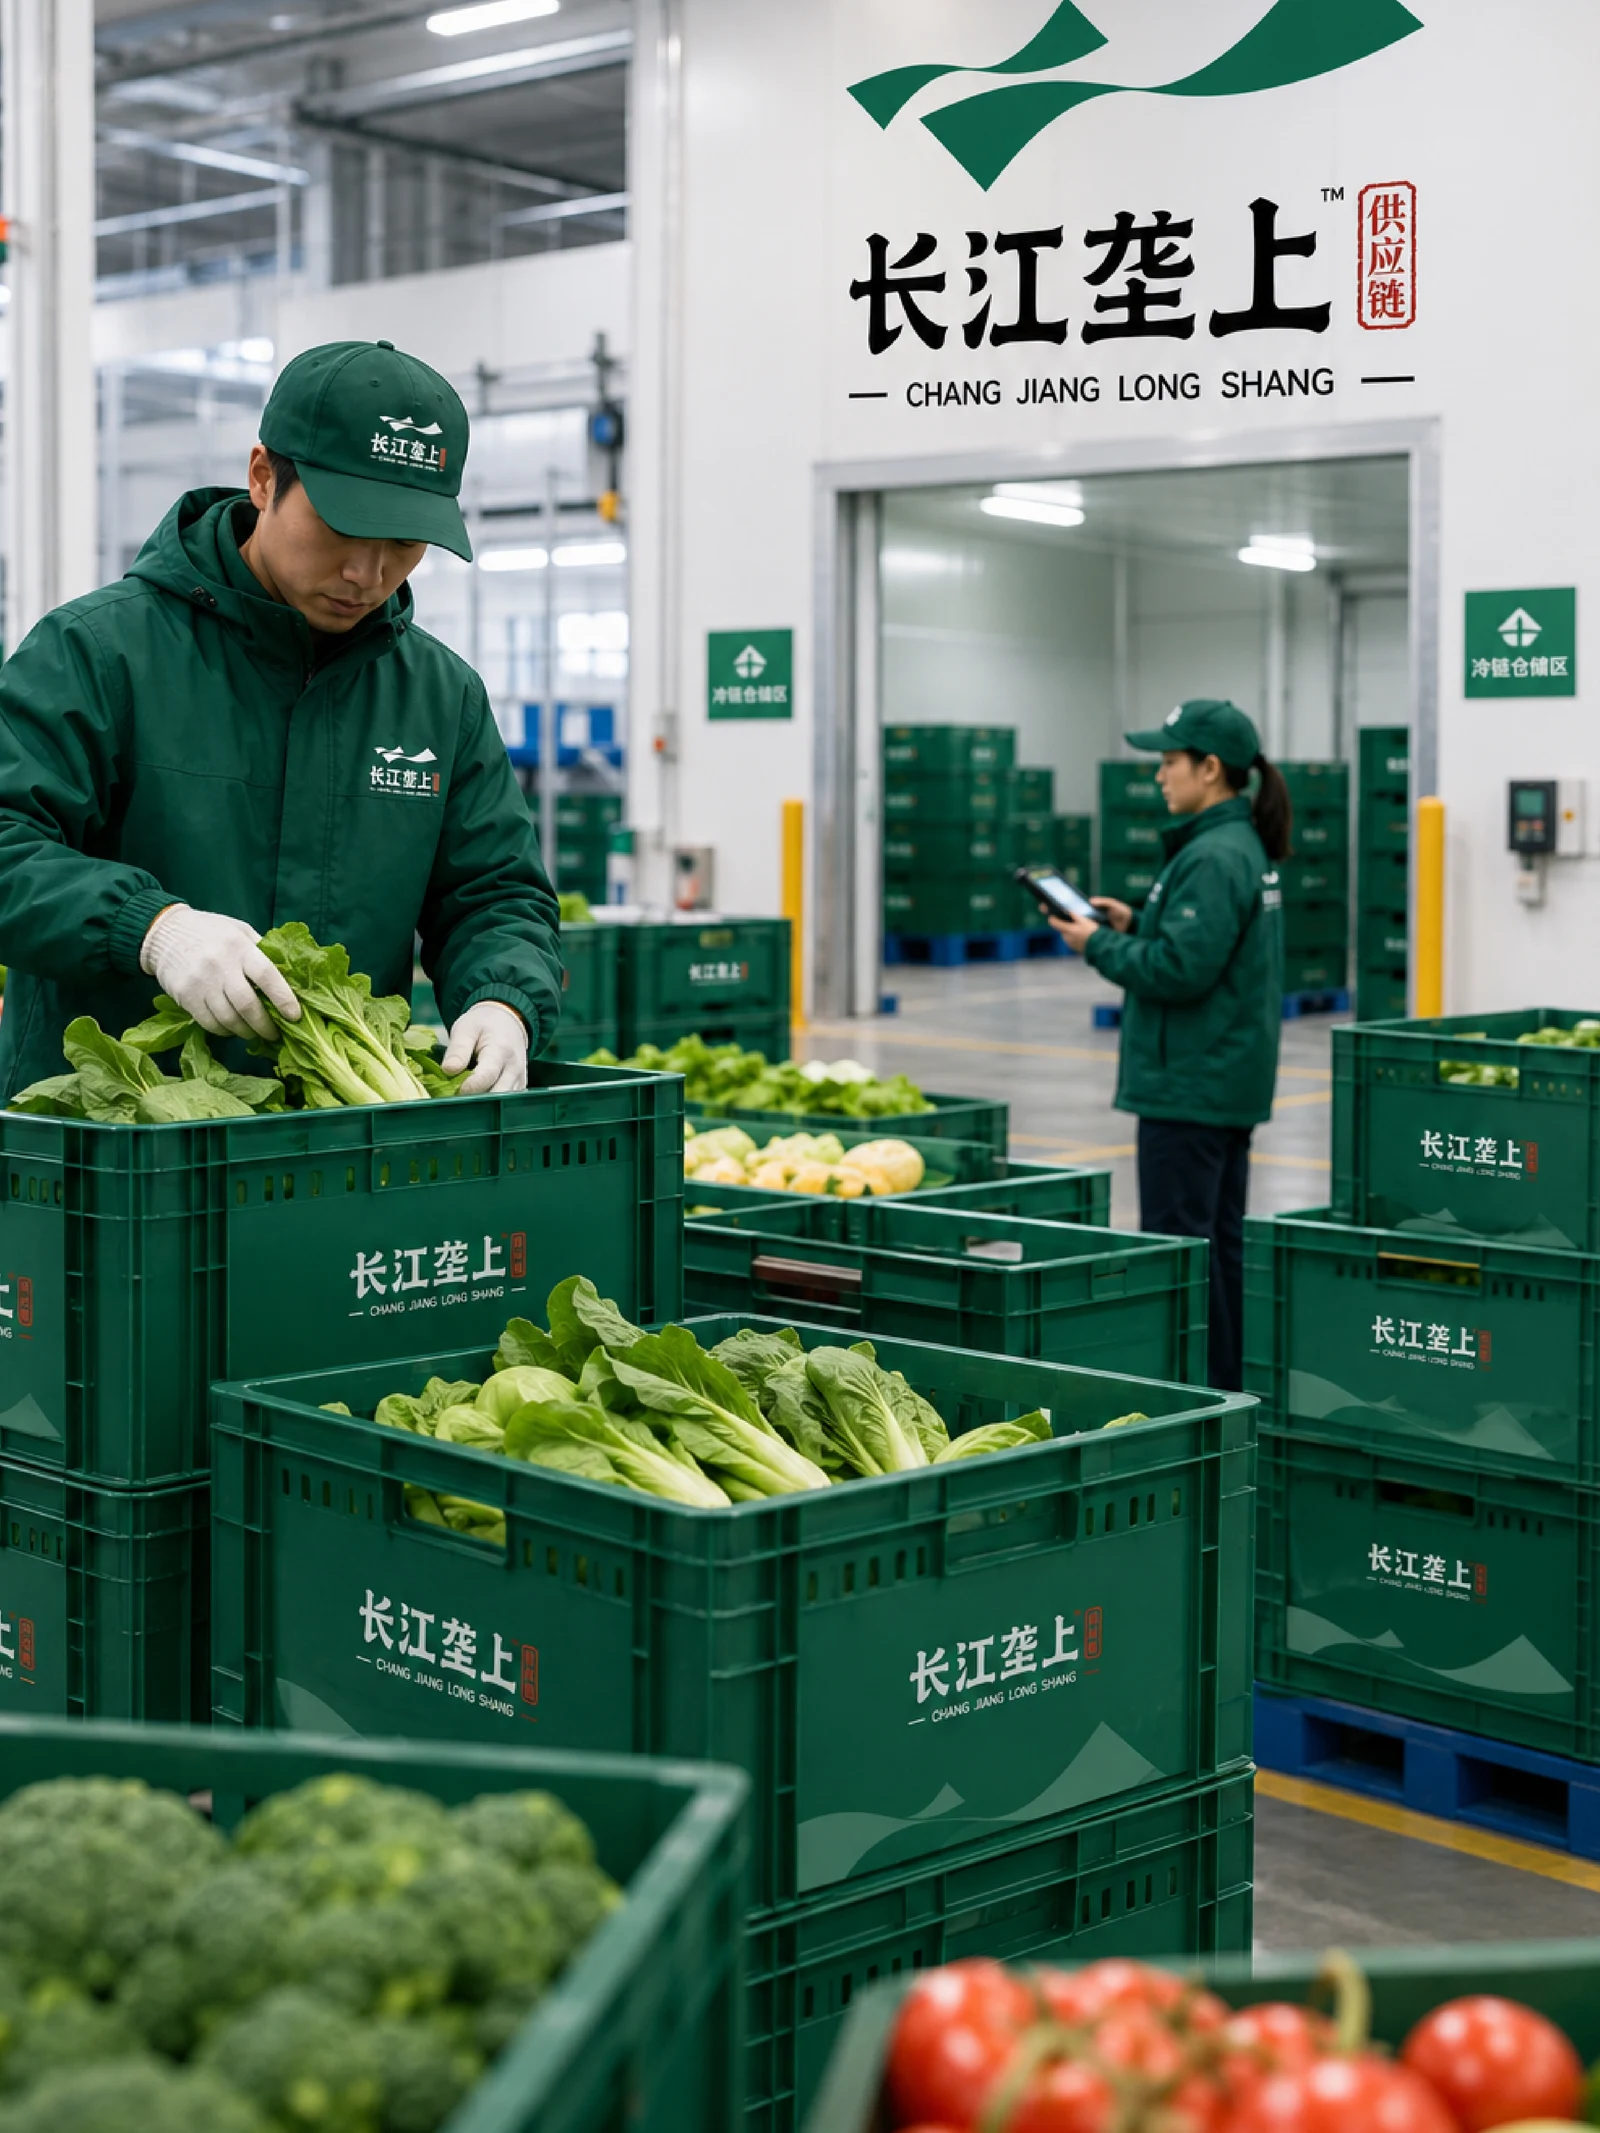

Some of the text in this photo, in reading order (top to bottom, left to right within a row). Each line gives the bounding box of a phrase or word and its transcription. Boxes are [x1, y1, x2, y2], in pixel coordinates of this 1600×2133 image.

[849, 196, 1332, 355] 长江垄上
[1367, 192, 1407, 319] 供应链
[906, 367, 1335, 407] CHANG JIANG LONG SHANG
[1420, 1129, 1523, 1169] 长江垄上
[349, 1235, 506, 1299] 长江垄上
[1371, 1315, 1476, 1357] 长江垄上
[1368, 1543, 1472, 1590] 长江垄上
[359, 1589, 516, 1694] 长江垄上
[909, 1614, 1079, 1704] 长江垄上
